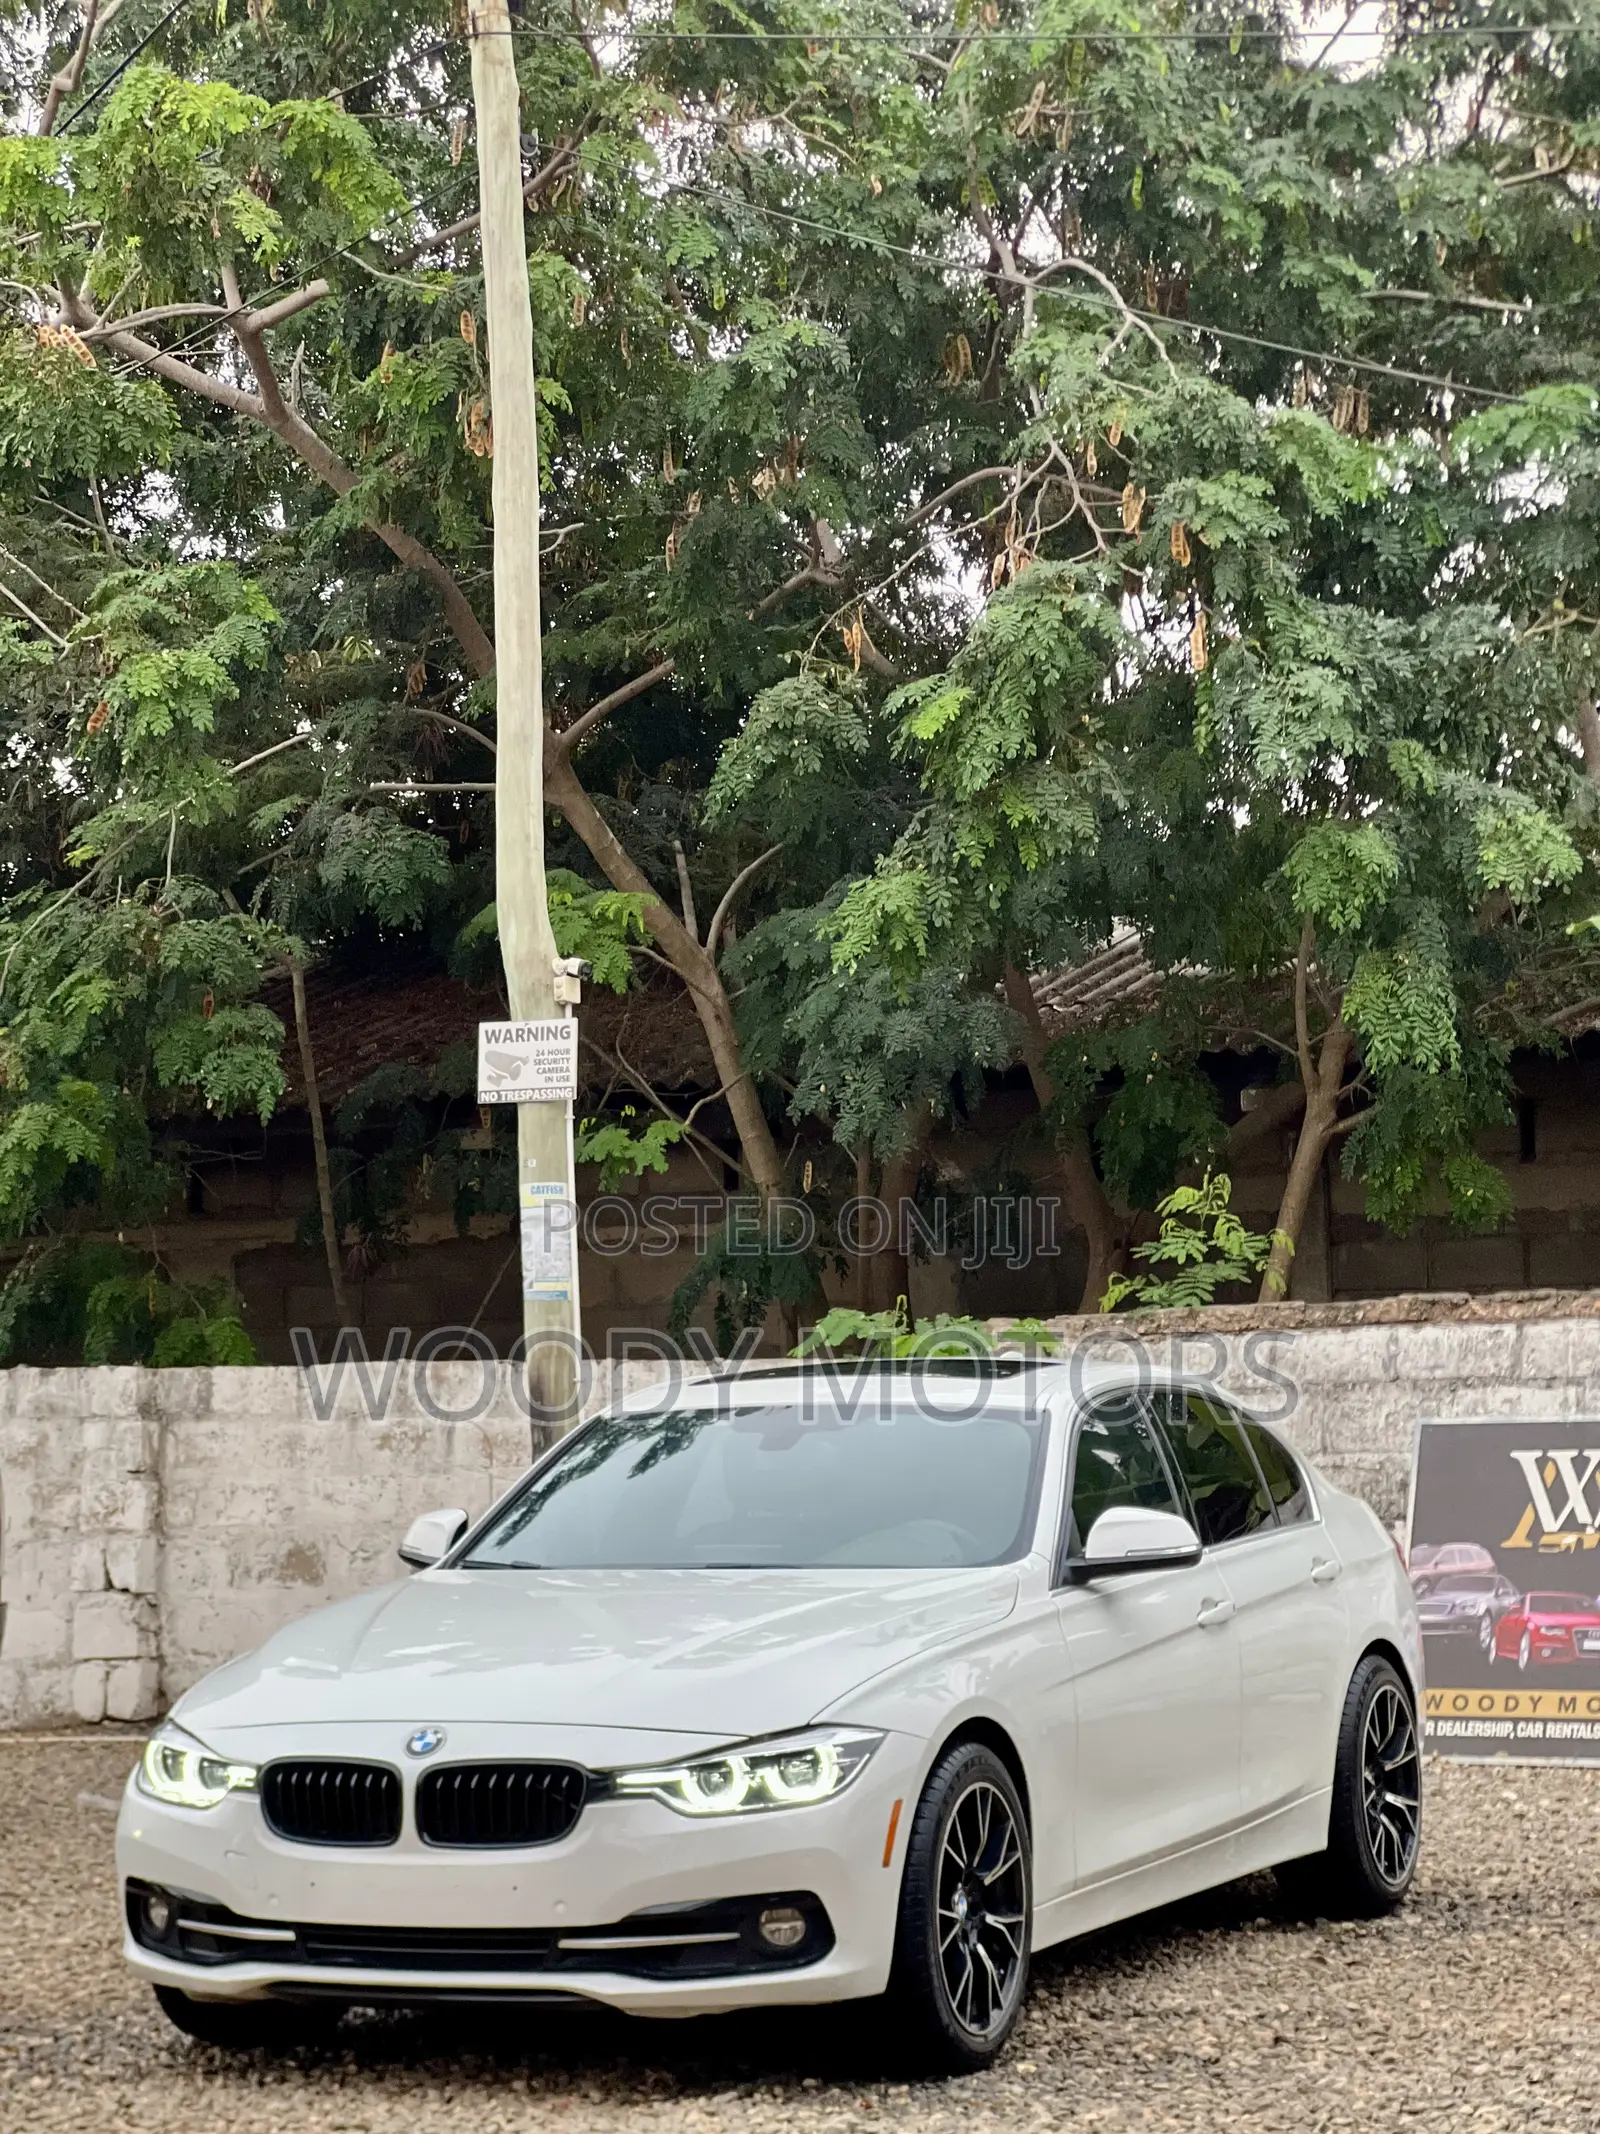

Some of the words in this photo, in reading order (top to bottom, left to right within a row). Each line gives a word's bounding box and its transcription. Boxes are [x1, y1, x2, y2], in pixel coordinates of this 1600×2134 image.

[485, 1025, 571, 1044] WARNING
[533, 1057, 571, 1066] SECURITY
[536, 1066, 571, 1074] CAMERA
[556, 1075, 571, 1083] USE
[481, 1091, 499, 1102] NO
[500, 1088, 573, 1100] TRESPASSING
[530, 1185, 564, 1195] CATFISH
[1426, 1694, 1543, 1713] WOODY
[1436, 1720, 1514, 1739] DEALERSHIP,
[1516, 1722, 1543, 1738] CAR
